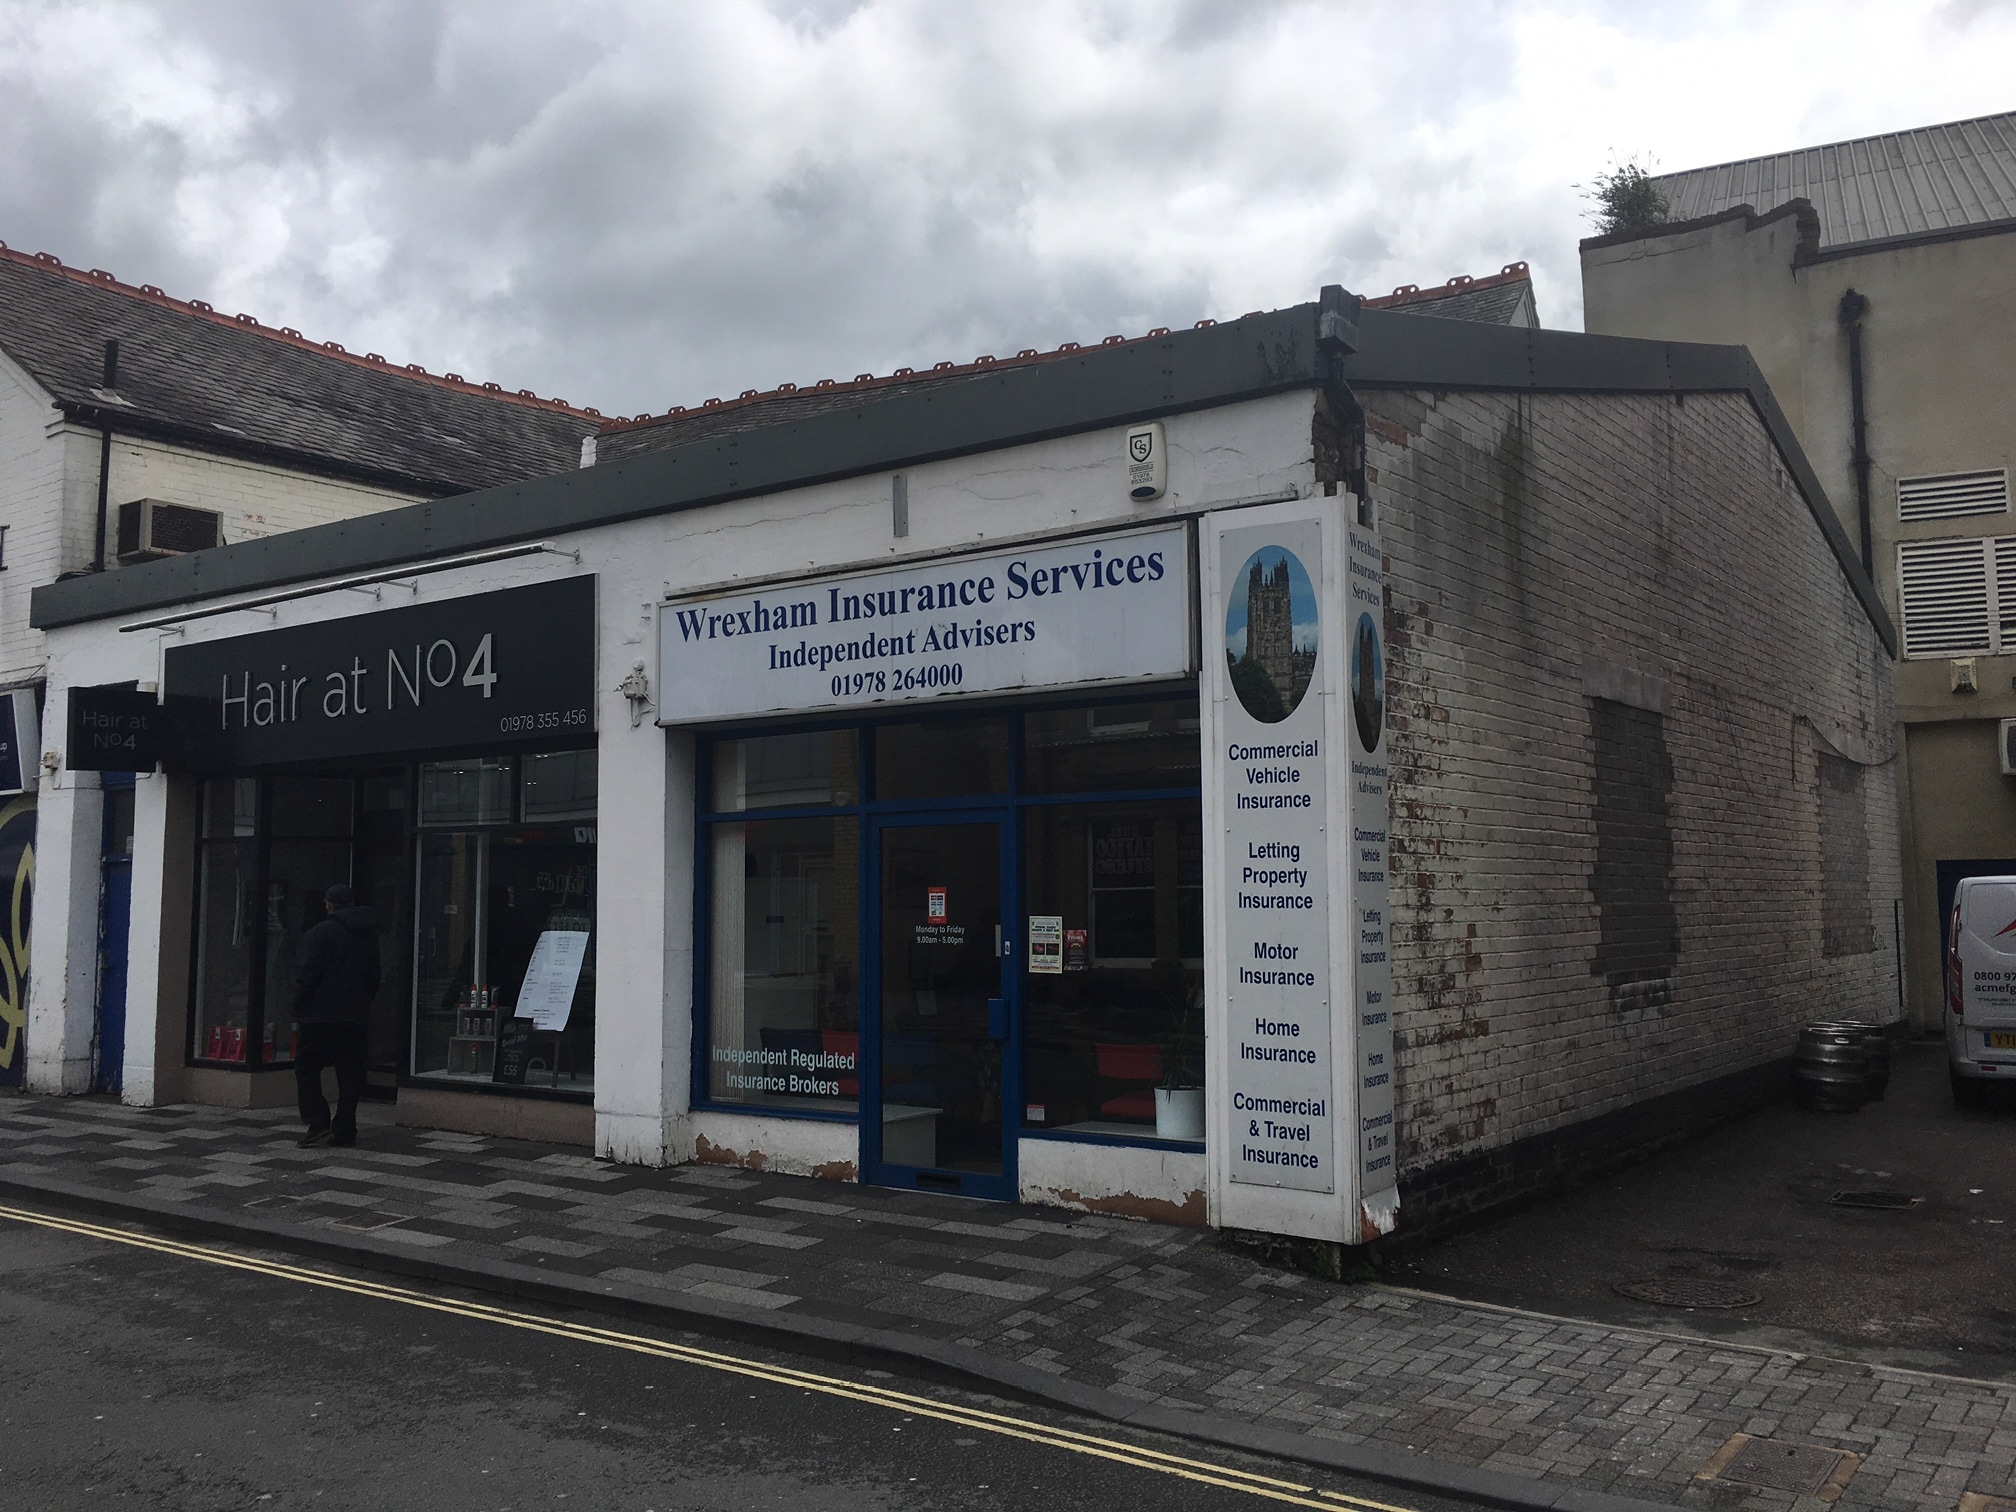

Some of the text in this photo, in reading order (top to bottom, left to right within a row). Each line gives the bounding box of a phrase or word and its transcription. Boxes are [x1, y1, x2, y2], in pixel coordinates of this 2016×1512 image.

[1349, 532, 1380, 560] Wrexham
[1349, 556, 1382, 584] Insurance
[676, 549, 1165, 643] Wrexham Insurance Services
[1352, 581, 1380, 606] Services
[768, 617, 1036, 671] Independent Advisers
[831, 662, 963, 697] 01978 264000
[221, 663, 308, 730] Hair
[322, 656, 367, 718] at
[82, 710, 148, 730] Hair at
[500, 708, 587, 732] 01978 355 456
[1228, 740, 1318, 761] Commercial
[1246, 766, 1300, 784] Vehicle
[1352, 760, 1388, 778] Independent
[1358, 781, 1382, 795] Advisers
[1236, 793, 1312, 810] Insurance
[1354, 826, 1386, 842] Commercial
[1248, 842, 1300, 864] Letting
[1360, 848, 1380, 862] Vehicle
[1242, 867, 1308, 888] Property
[1358, 868, 1384, 882] Insurance
[1238, 891, 1314, 910] Insurance
[1363, 909, 1382, 925] Letting
[916, 925, 965, 936] Monday to Friday
[1362, 930, 1384, 946] Property
[1254, 942, 1298, 960] Motor
[1360, 950, 1386, 964] Insurance
[1240, 966, 1315, 986] Insurance
[1974, 972, 2000, 980] 0800
[1366, 990, 1382, 1004] Motor
[1255, 1018, 1300, 1038] Home
[1362, 1012, 1388, 1026] Insurance
[712, 1044, 855, 1072] Independent Regulated
[1240, 1042, 1316, 1065] Insurance
[1368, 1052, 1384, 1066] Home
[726, 1070, 840, 1096] Insurance Brokers
[1364, 1072, 1389, 1088] Insurance
[1234, 1092, 1326, 1117] Commercial
[1362, 1109, 1392, 1132] Commercial
[1249, 1120, 1311, 1142] & Travel
[1368, 1132, 1389, 1151] & Travel
[1242, 1144, 1319, 1169] Insurance
[1366, 1154, 1391, 1174] Insurance
